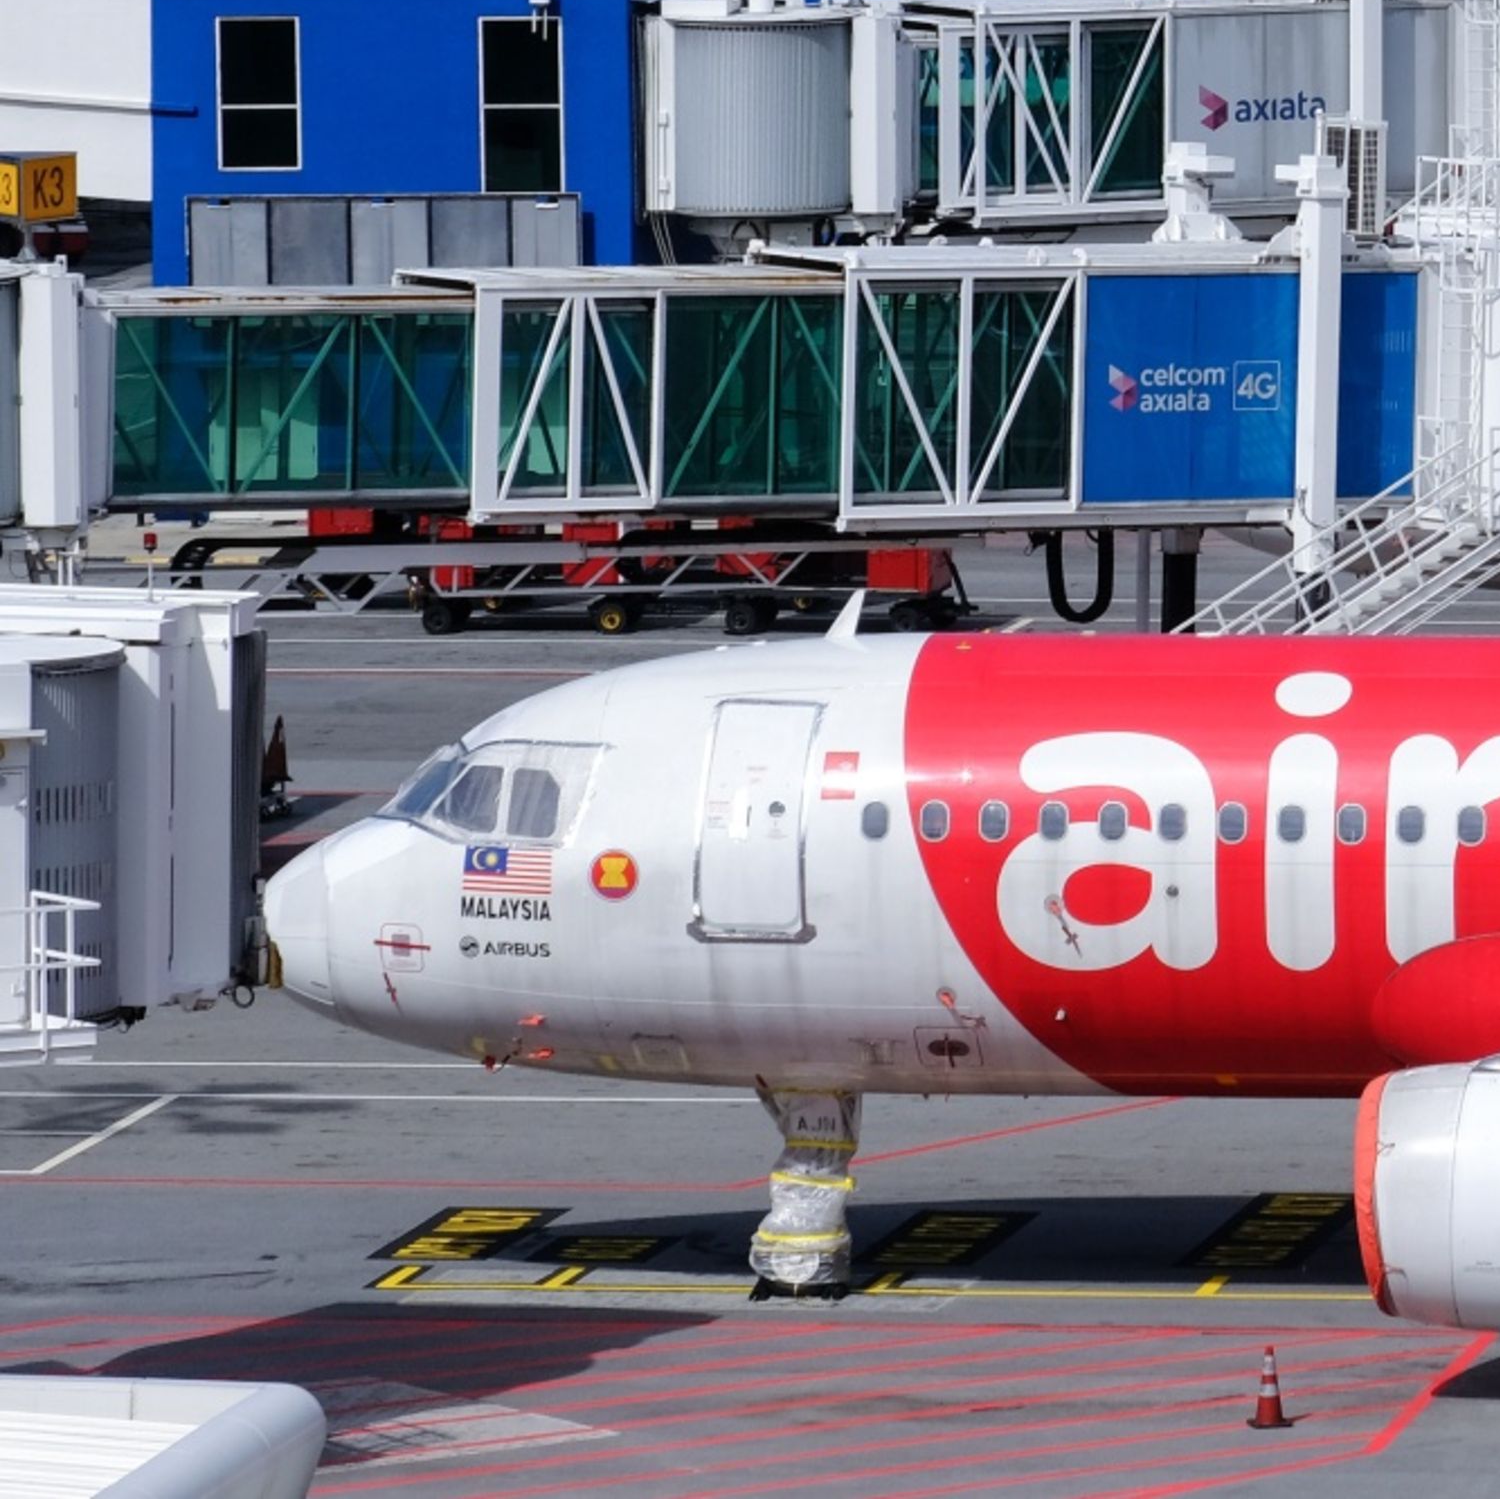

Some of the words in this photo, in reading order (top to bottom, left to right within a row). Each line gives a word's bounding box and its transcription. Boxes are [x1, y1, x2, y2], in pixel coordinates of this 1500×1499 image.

[1234, 90, 1326, 123] axiata
[33, 166, 64, 210] K3
[1140, 363, 1226, 387] celcom
[1237, 371, 1277, 400] 4G
[1140, 387, 1211, 412] axiata
[461, 896, 552, 921] MALAYSIA
[484, 941, 552, 958] AIRBUS
